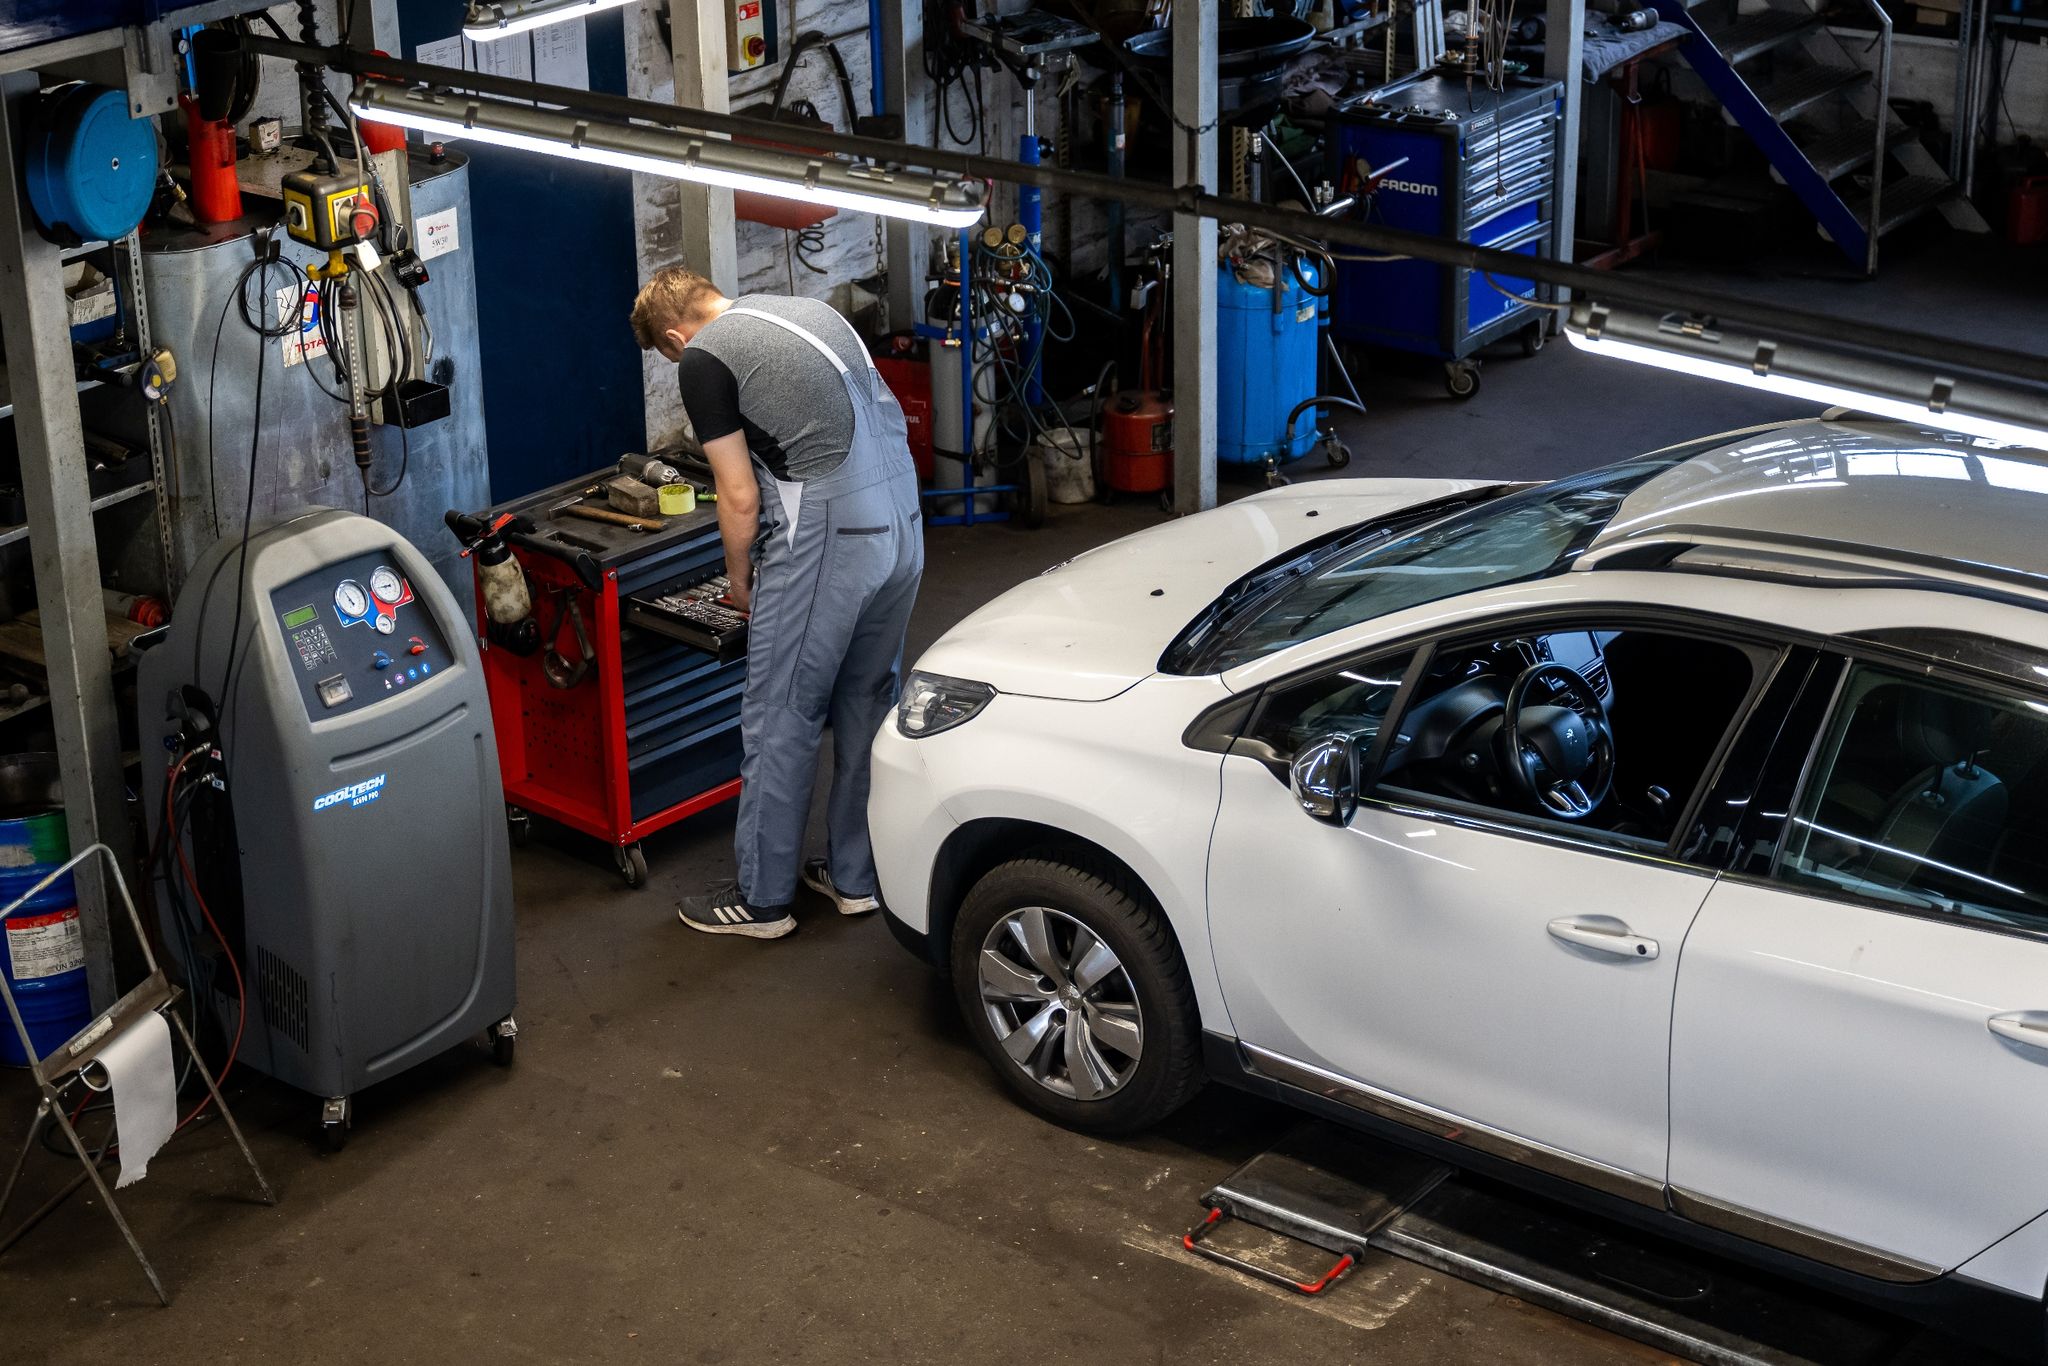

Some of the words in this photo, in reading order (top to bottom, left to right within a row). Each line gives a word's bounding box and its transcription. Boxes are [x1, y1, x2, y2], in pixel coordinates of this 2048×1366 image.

[1376, 178, 1438, 197] FACOM
[295, 338, 328, 352] TOTA
[314, 774, 386, 810] COOLTECH
[368, 790, 379, 801] PRO
[55, 963, 67, 972] UN
